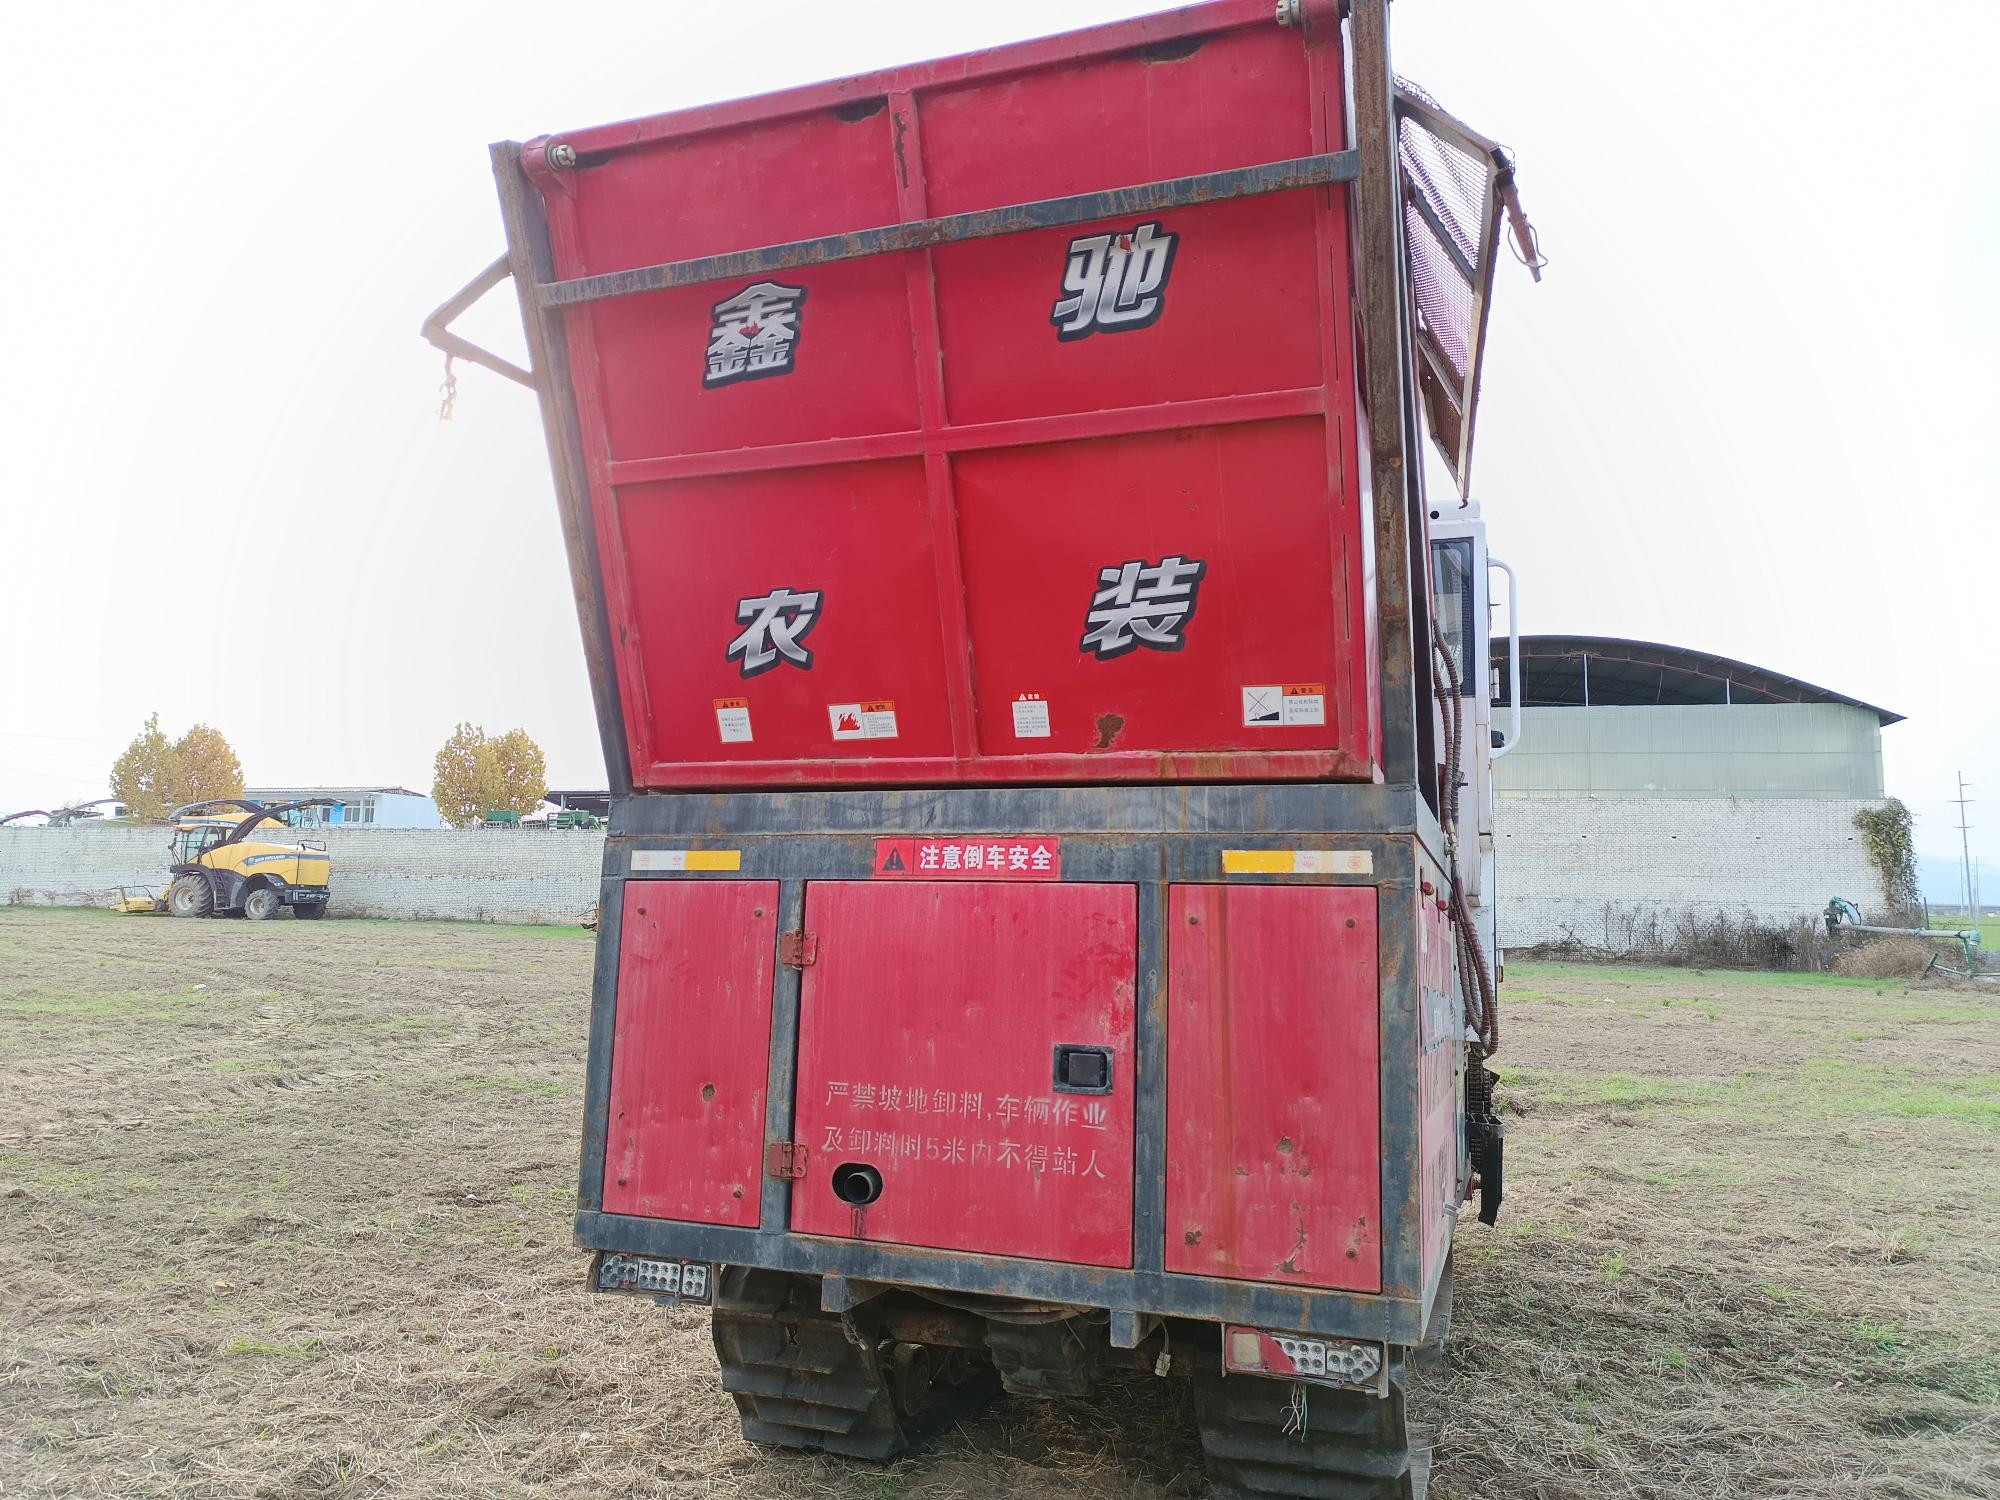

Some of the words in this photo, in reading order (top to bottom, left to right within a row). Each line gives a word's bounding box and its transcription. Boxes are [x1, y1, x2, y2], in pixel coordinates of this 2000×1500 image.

[704, 281, 805, 386] 鑫
[1050, 223, 1177, 338] 驰
[726, 589, 822, 676] 农
[1080, 556, 1204, 658] 装
[919, 844, 1053, 871] 注意倒车安全
